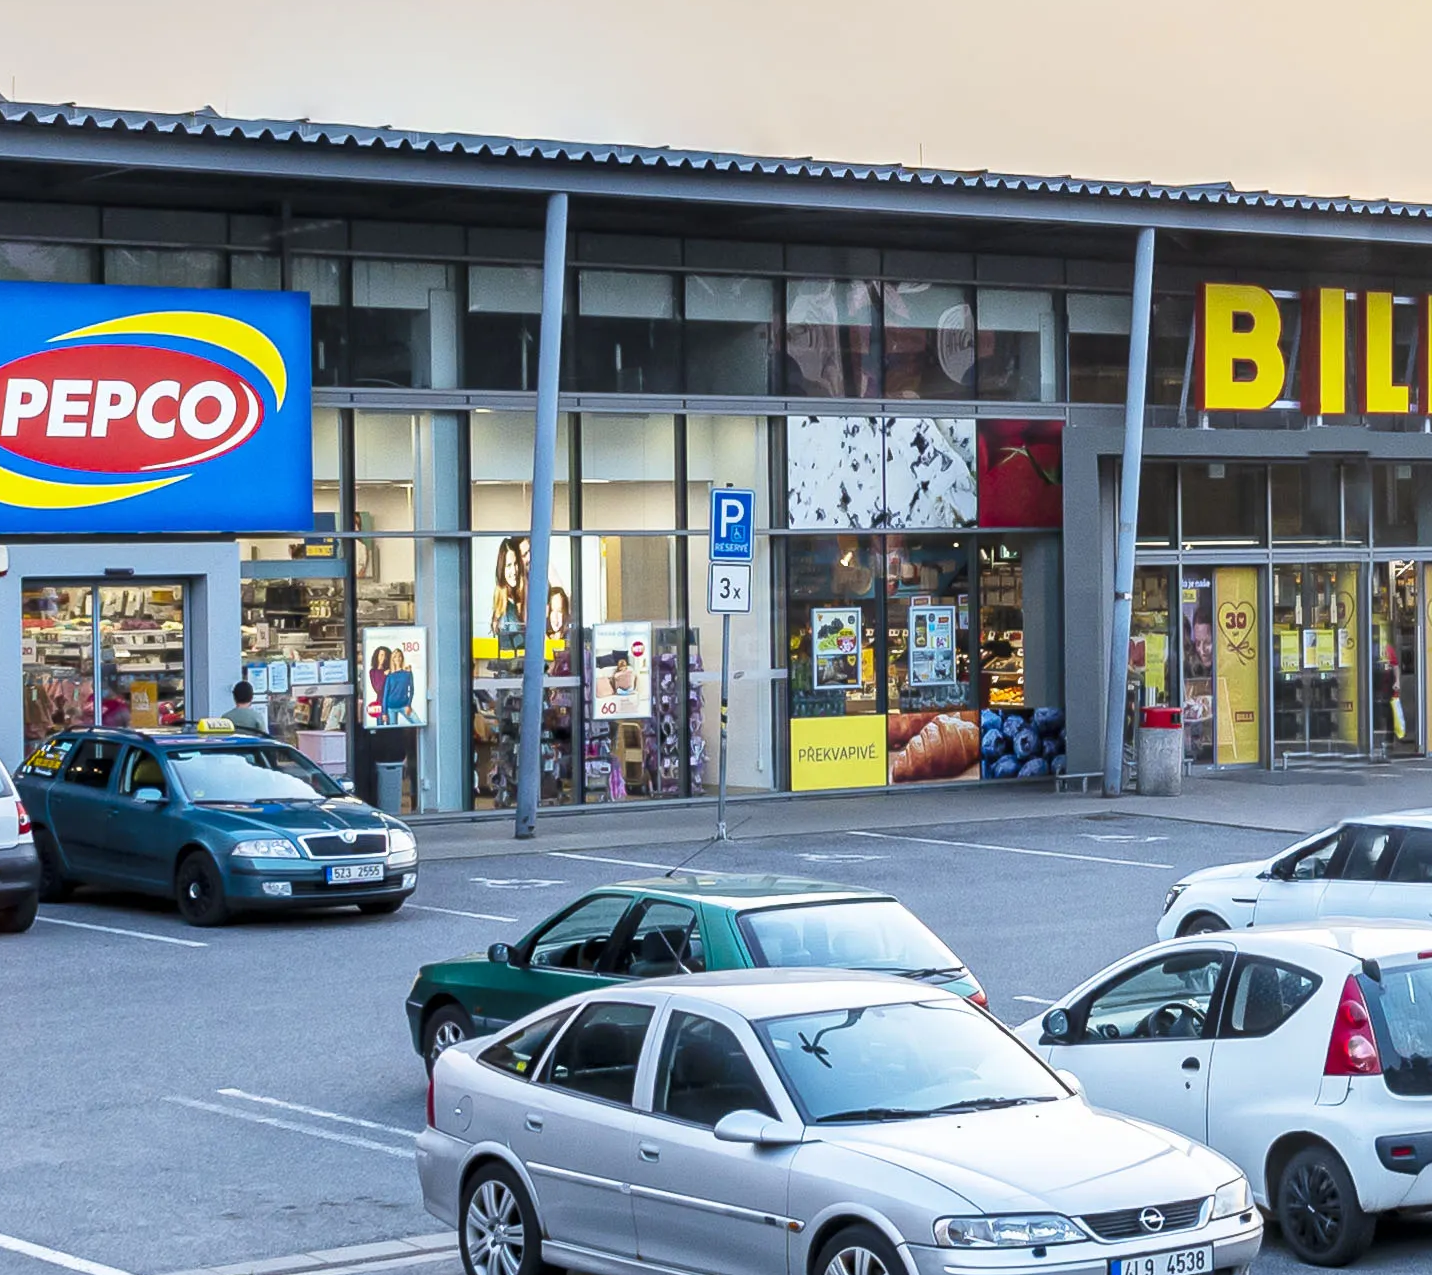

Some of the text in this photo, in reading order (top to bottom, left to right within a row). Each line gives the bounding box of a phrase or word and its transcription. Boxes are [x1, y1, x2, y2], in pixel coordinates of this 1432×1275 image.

[0, 377, 237, 440] PEPCO
[720, 498, 745, 538] P
[1225, 612, 1247, 630] 30
[401, 642, 420, 653] 180
[601, 702, 617, 715] 60
[334, 865, 380, 879] 5Z3 2555
[1167, 1250, 1205, 1275] 4538
